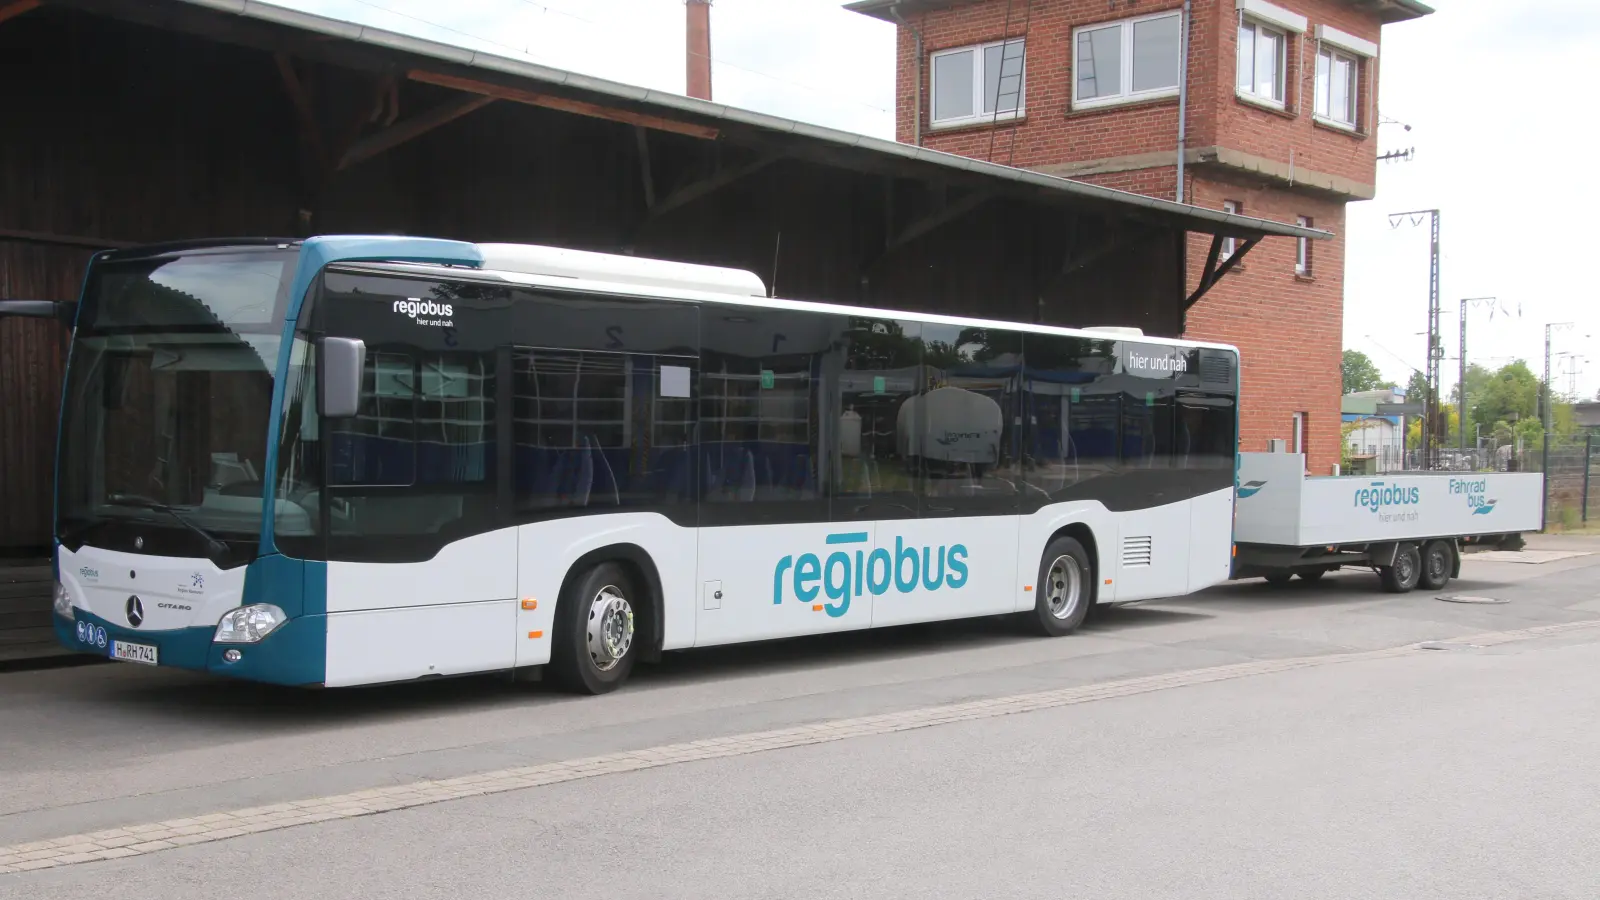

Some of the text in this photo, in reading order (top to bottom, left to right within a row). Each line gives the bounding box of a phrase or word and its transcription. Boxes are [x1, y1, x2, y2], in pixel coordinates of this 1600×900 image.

[393, 297, 453, 318] regiobus
[416, 317, 453, 328] hier und nah
[1129, 350, 1187, 372] hier und nah
[1449, 478, 1486, 495] Fahrrad
[1354, 481, 1420, 513] regiobus
[1468, 493, 1485, 507] bus
[1379, 510, 1419, 522] hier und nah
[773, 532, 969, 618] regiobus
